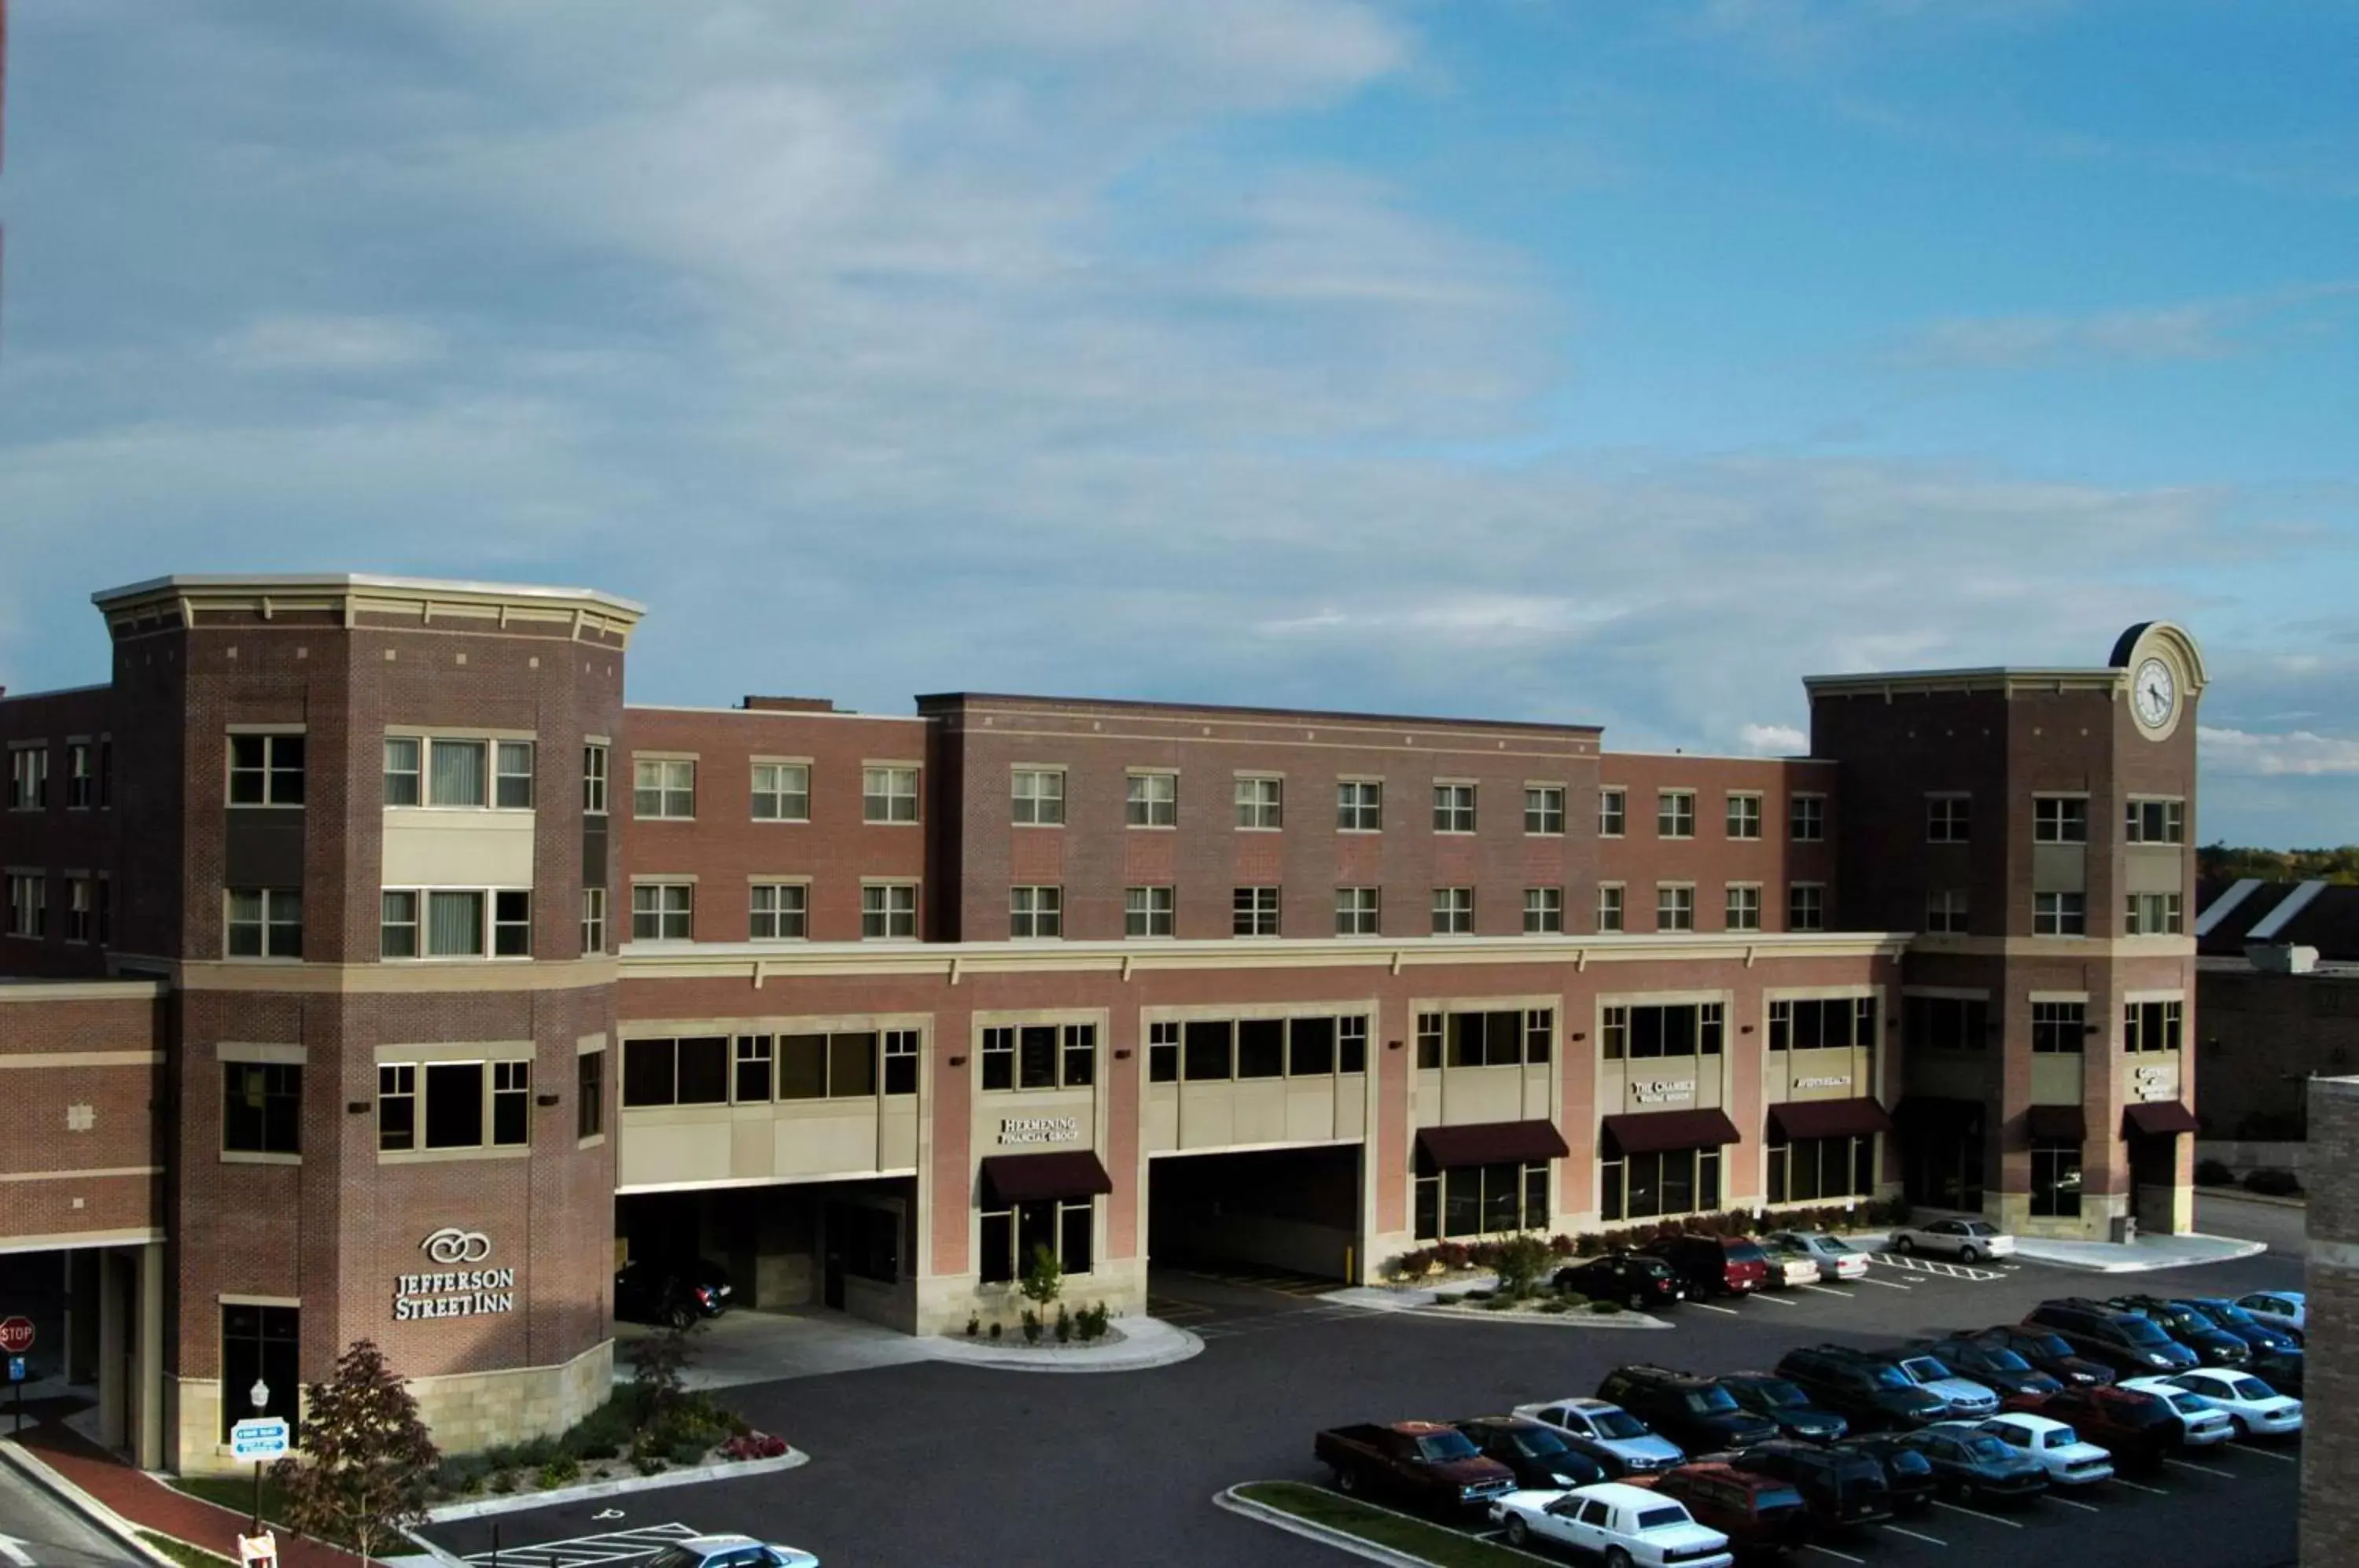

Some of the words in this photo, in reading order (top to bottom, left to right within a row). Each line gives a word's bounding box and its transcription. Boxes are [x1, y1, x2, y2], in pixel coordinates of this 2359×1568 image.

[396, 1268, 513, 1297] JEFFERSON
[396, 1297, 473, 1320] STREET
[473, 1292, 513, 1314] INN
[2, 1326, 32, 1341] STOP
